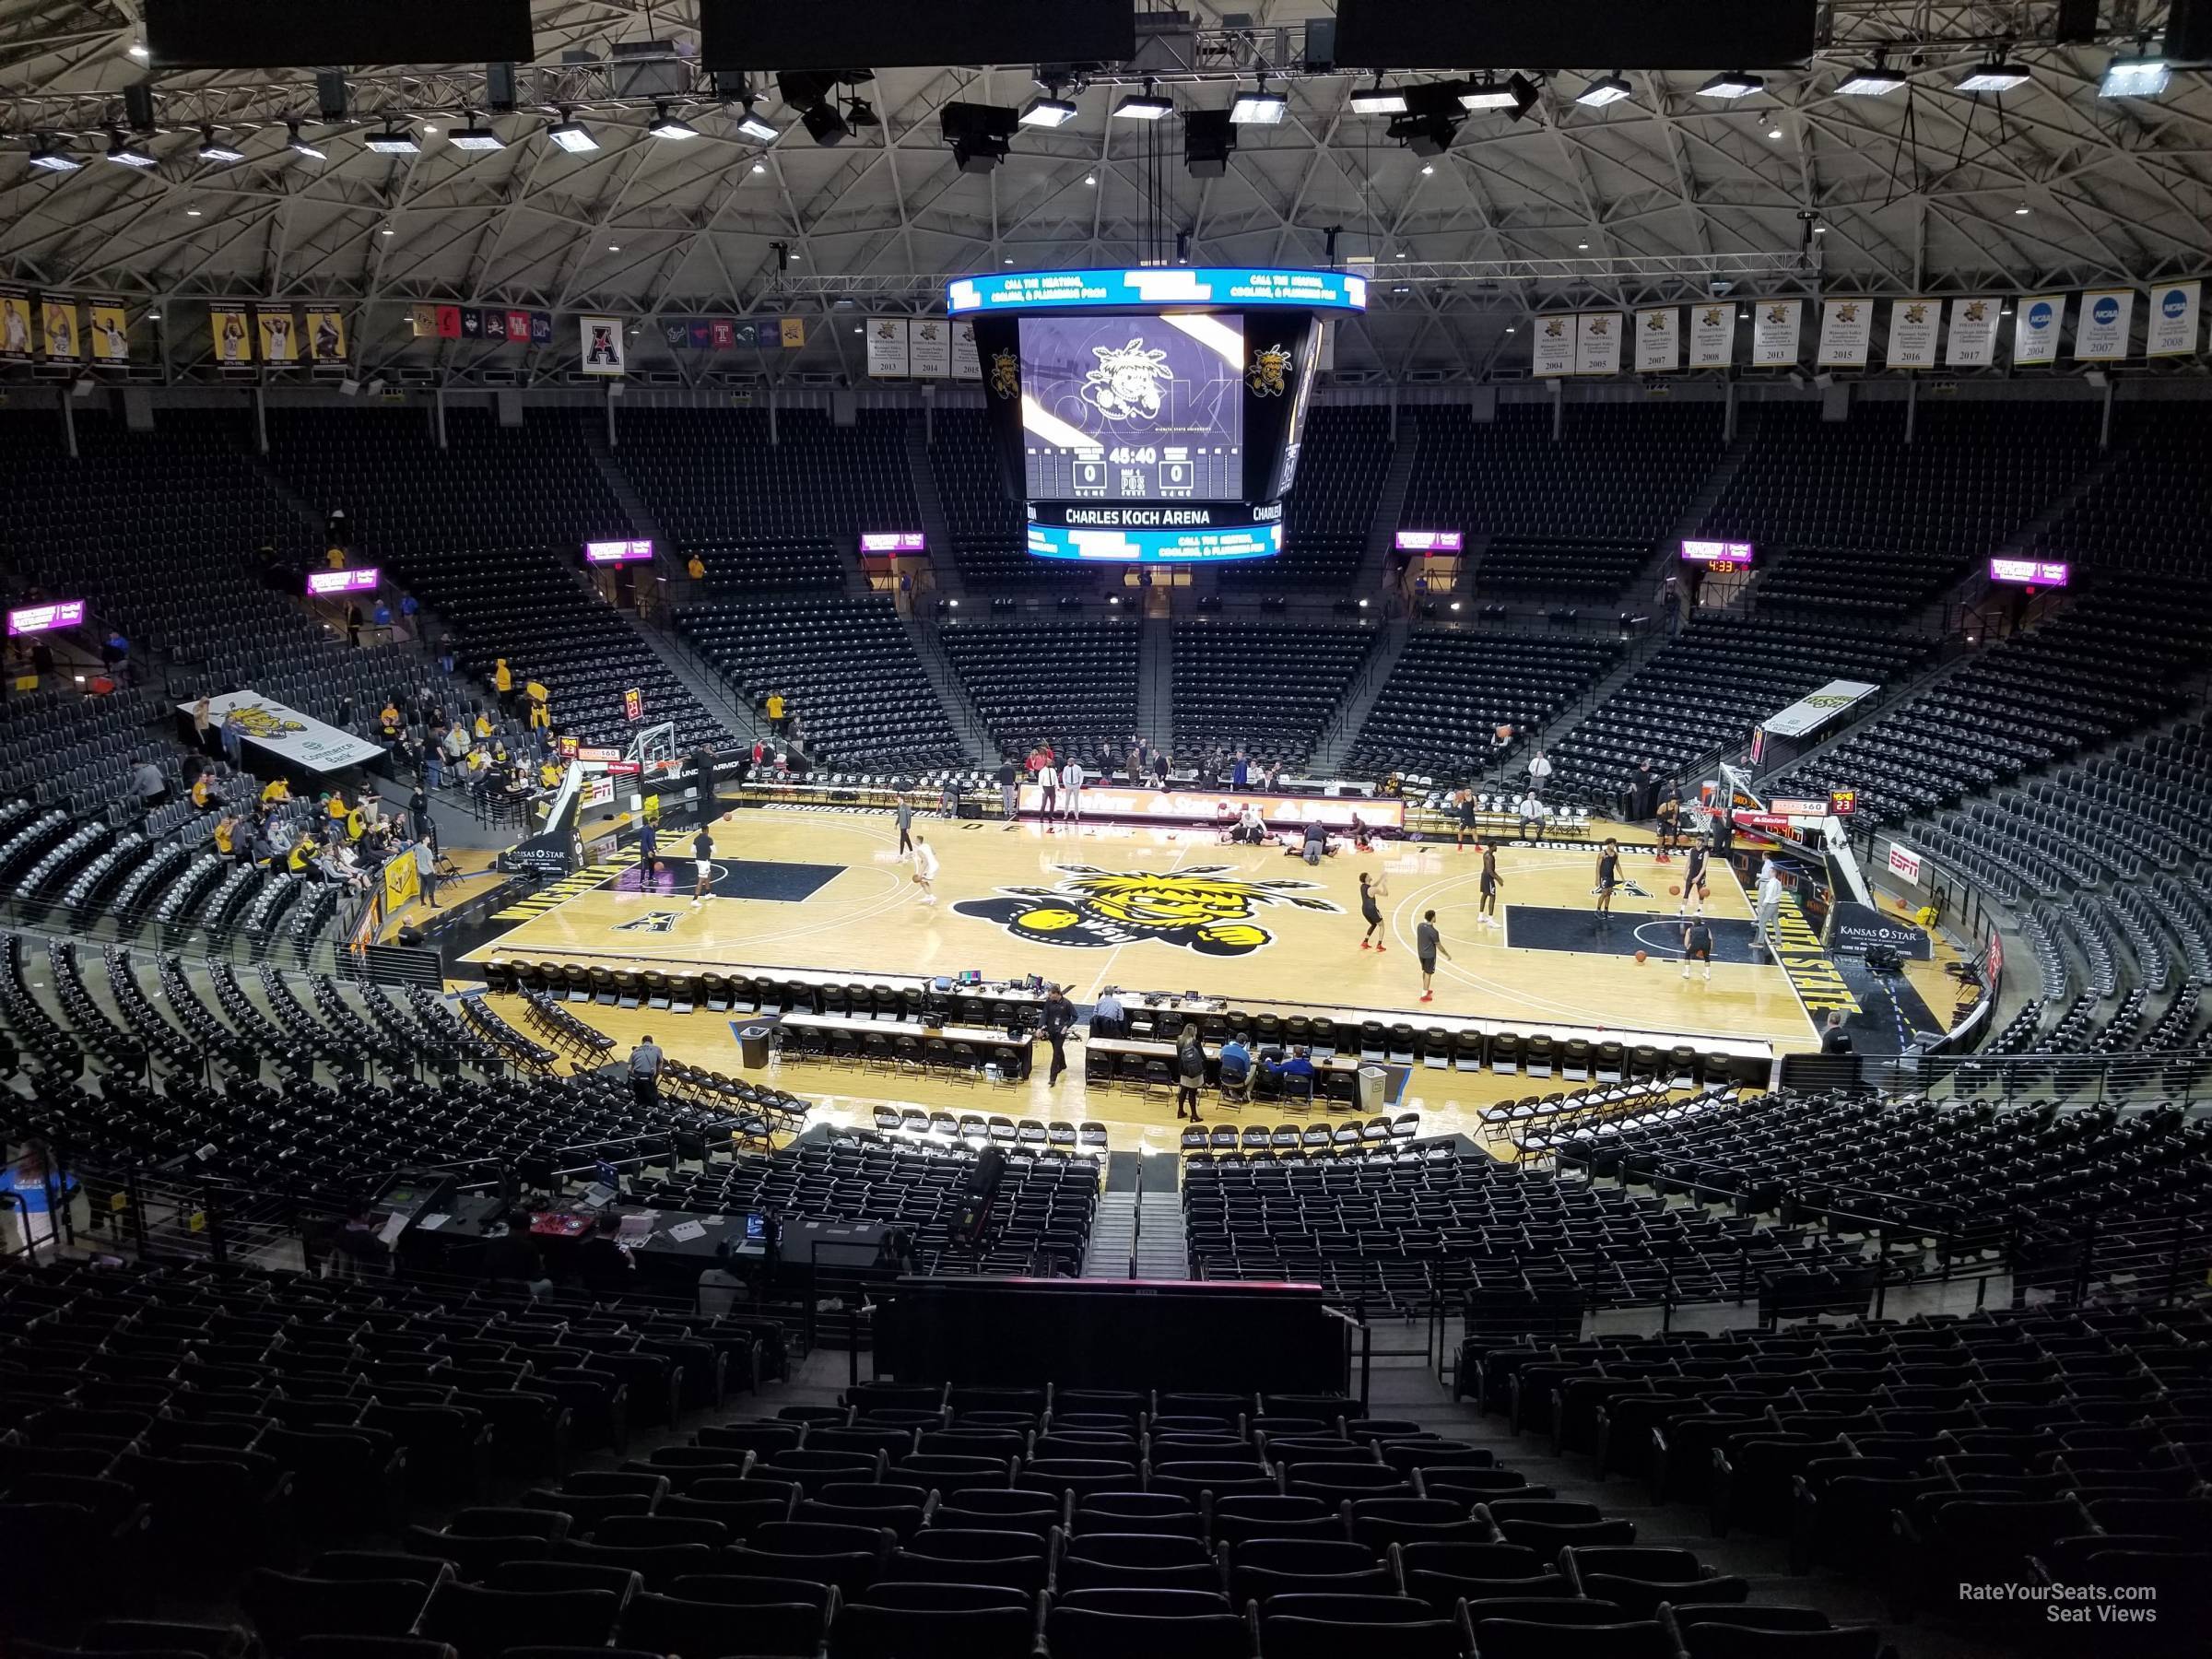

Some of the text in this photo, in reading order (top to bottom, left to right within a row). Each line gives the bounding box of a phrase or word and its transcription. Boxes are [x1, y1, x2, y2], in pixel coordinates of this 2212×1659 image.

[2030, 314, 2052, 323] NCAA
[2095, 310, 2119, 319] NCAA
[2161, 337, 2183, 347] 2008
[2026, 347, 2045, 356] 2004
[2089, 343, 2115, 352] 2007
[1702, 353, 1720, 361] 2008
[1833, 350, 1853, 359] 2015
[1901, 353, 1921, 361] 2016
[1959, 351, 1980, 359] 2017
[1588, 360, 1607, 369] 2005
[1648, 357, 1665, 365] 2007
[923, 364, 937, 372] 2014
[1109, 447, 1157, 464] 45:40
[1084, 465, 1096, 482] 0
[1171, 465, 1182, 482] 0
[1121, 477, 1145, 490] POS
[1065, 509, 1210, 525] CHARLES KOCH ARENA
[1709, 560, 1734, 572] 4:33
[301, 743, 355, 760] Commerce
[1833, 793, 1853, 801] 45:40
[1837, 801, 1850, 810] 23
[546, 850, 566, 859] STAR
[1890, 850, 1919, 878] ESPN
[489, 865, 633, 920] WICHITA
[1075, 919, 1138, 943] WSU
[1841, 925, 1877, 937] KANSAS
[1891, 930, 1917, 941] STAR
[1782, 957, 1863, 1014] STATE
